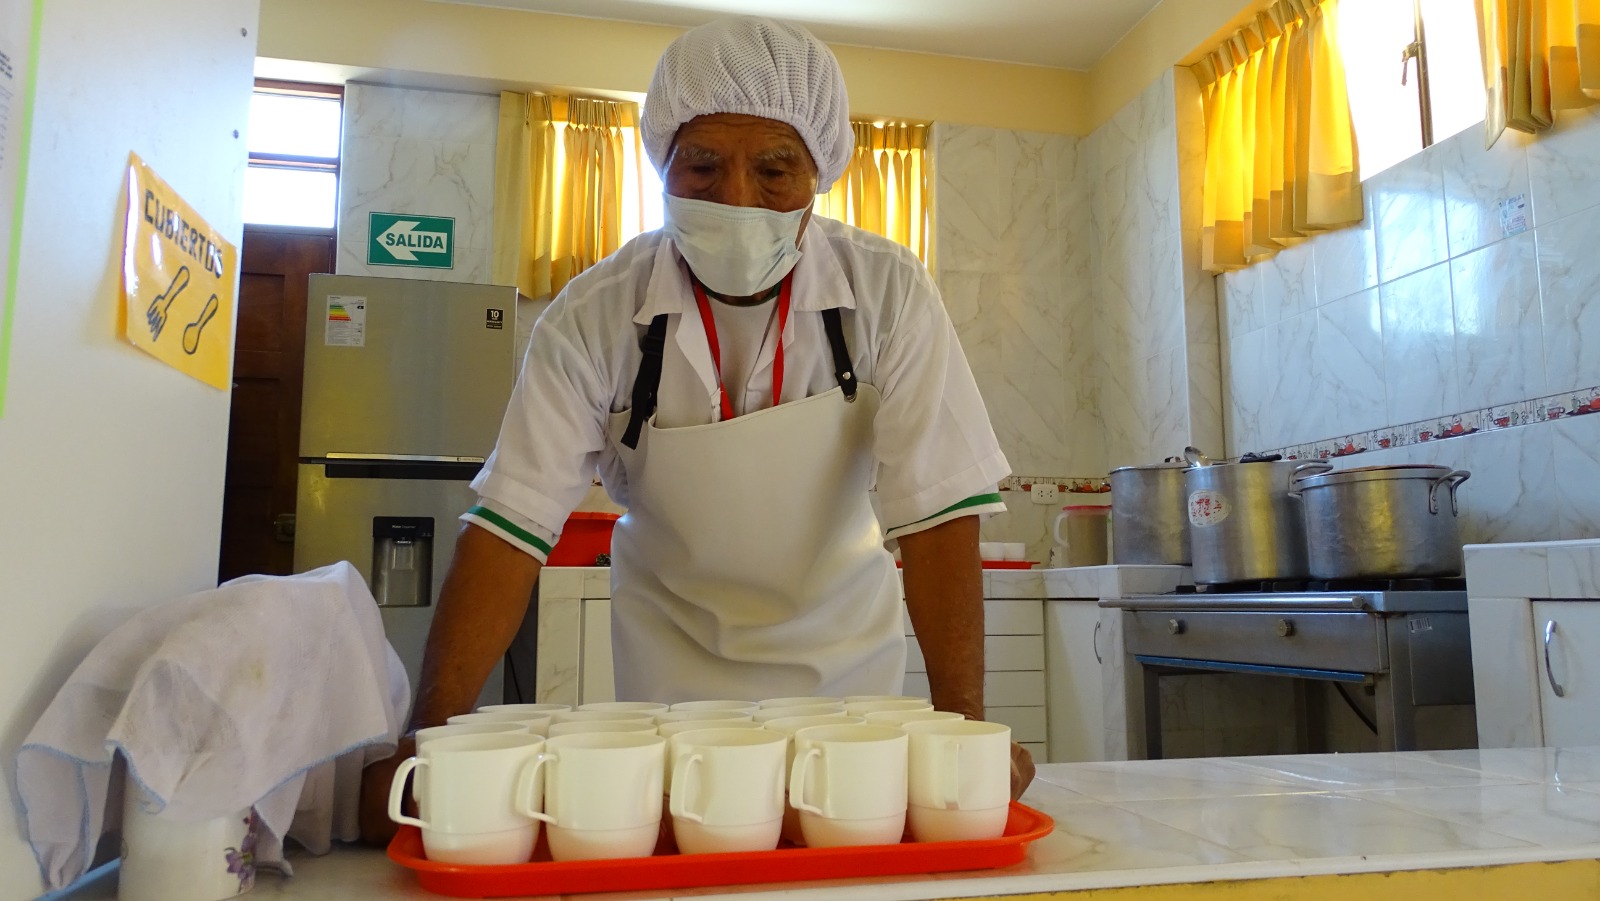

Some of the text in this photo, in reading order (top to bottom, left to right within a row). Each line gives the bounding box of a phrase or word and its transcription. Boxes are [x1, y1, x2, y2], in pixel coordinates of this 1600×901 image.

[143, 188, 223, 278] CUBIERTOS
[385, 232, 444, 249] SALIDA
[490, 310, 500, 318] 10
